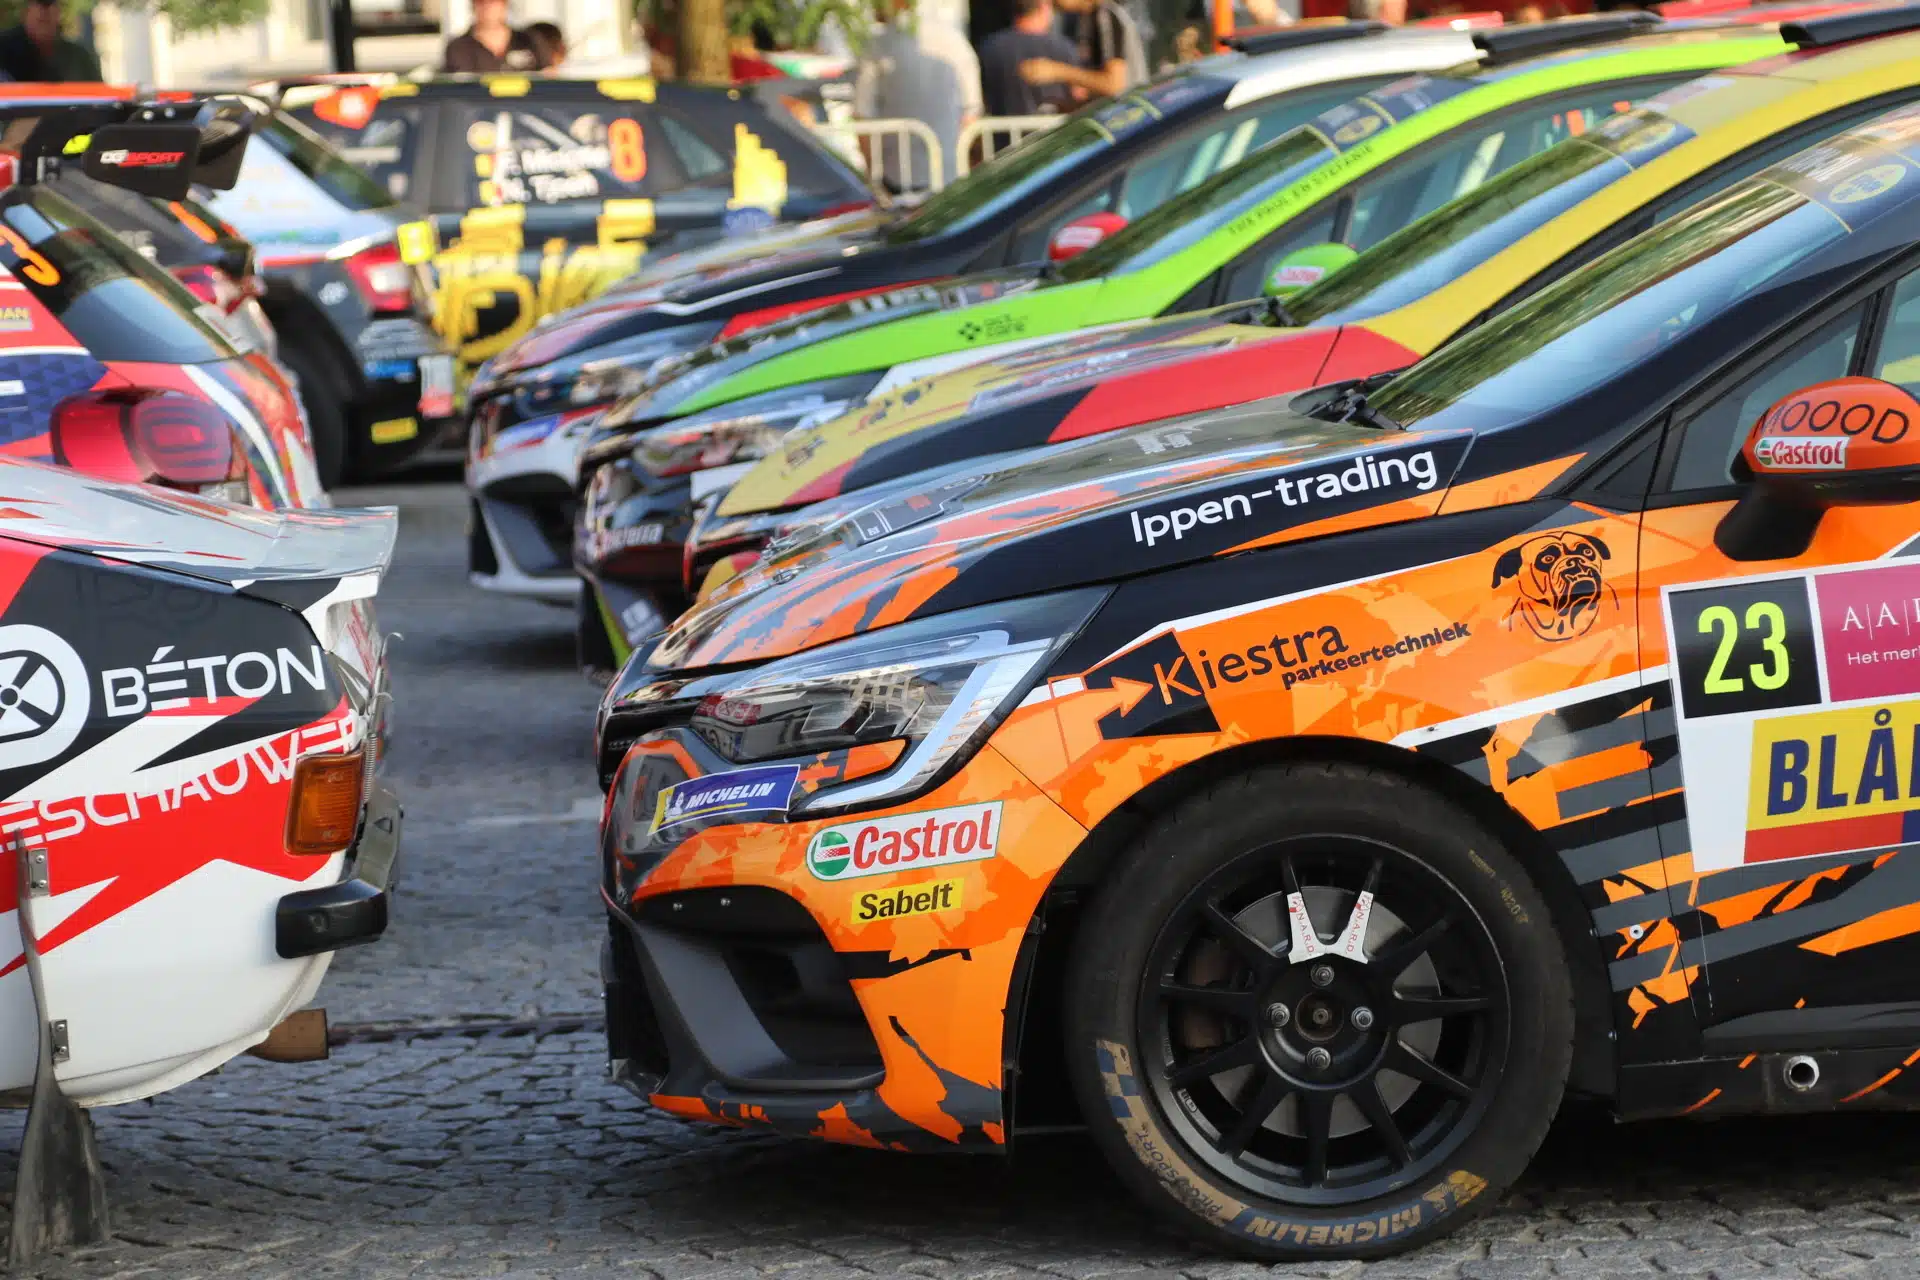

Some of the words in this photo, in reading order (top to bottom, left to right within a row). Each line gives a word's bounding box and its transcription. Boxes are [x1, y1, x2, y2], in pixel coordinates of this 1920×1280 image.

[608, 117, 648, 183] 8
[1771, 439, 1843, 465] Castrol
[1129, 450, 1438, 547] Ippen-trading
[1153, 625, 1349, 706] Kiestra
[1281, 621, 1472, 691] parkeertechniek
[1697, 601, 1790, 695] 23
[1847, 650, 1880, 666] Het
[1883, 645, 1920, 662] mer
[101, 645, 326, 718] BÉTON
[684, 781, 777, 810] MICHELIN
[1766, 708, 1920, 817] BLÅ
[853, 808, 993, 870] Castrol
[858, 882, 954, 920] Sabelt
[1244, 1203, 1423, 1246] MICHELIN
